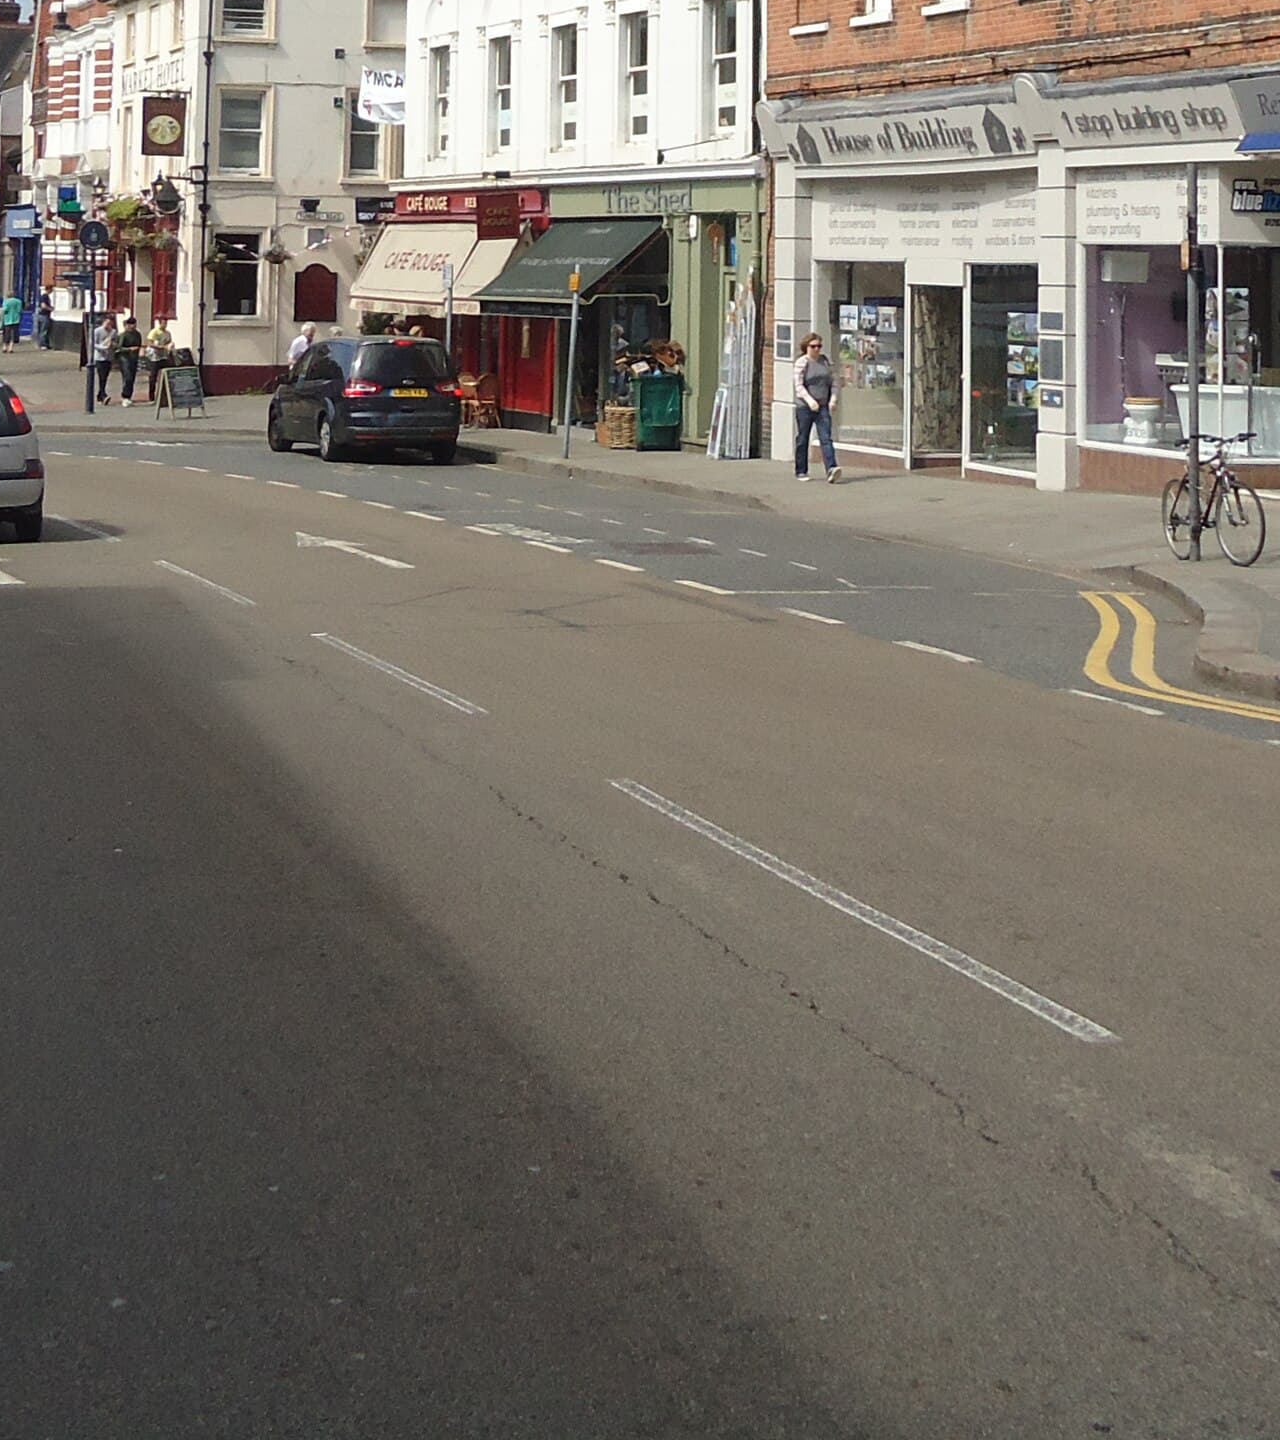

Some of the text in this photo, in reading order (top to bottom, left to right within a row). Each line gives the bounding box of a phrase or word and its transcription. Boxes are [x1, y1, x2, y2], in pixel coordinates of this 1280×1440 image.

[157, 58, 185, 87] HOTEL
[364, 69, 403, 88] YMCA
[821, 117, 978, 154] House of Building
[1061, 102, 1228, 140] 1 stop building shop
[424, 195, 448, 210] ROUGE
[602, 184, 692, 214] The Shed
[411, 252, 449, 272] ROUGE
